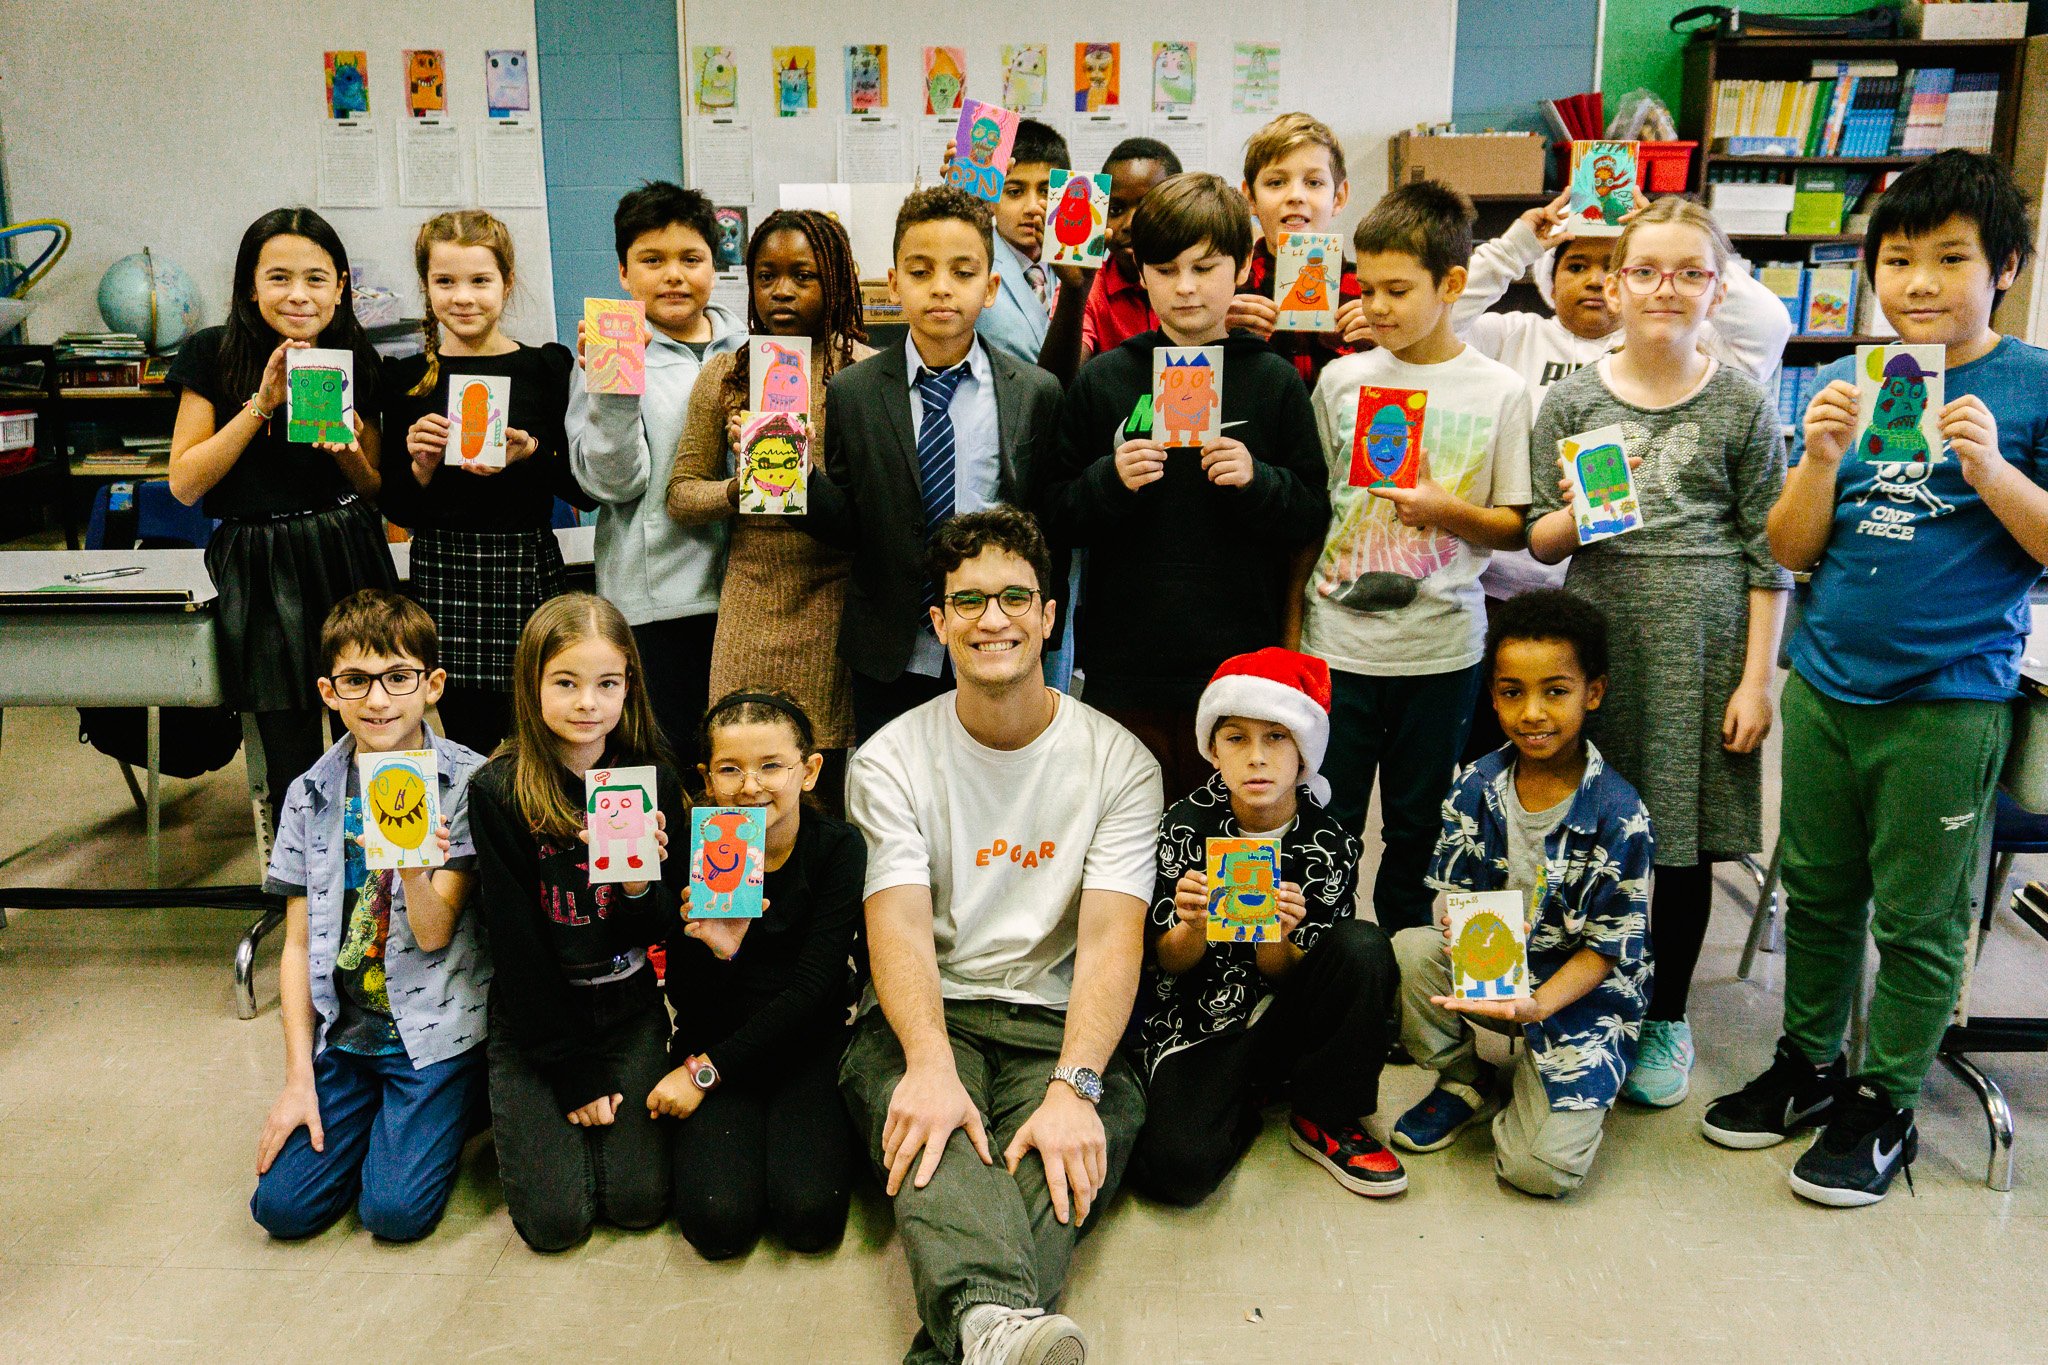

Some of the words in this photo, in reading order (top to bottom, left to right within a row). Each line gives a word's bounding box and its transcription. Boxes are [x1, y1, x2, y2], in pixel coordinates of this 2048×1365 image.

[1871, 505, 1916, 523] ONE
[1856, 520, 1916, 541] PIECE
[975, 838, 1056, 869] EDGAR
